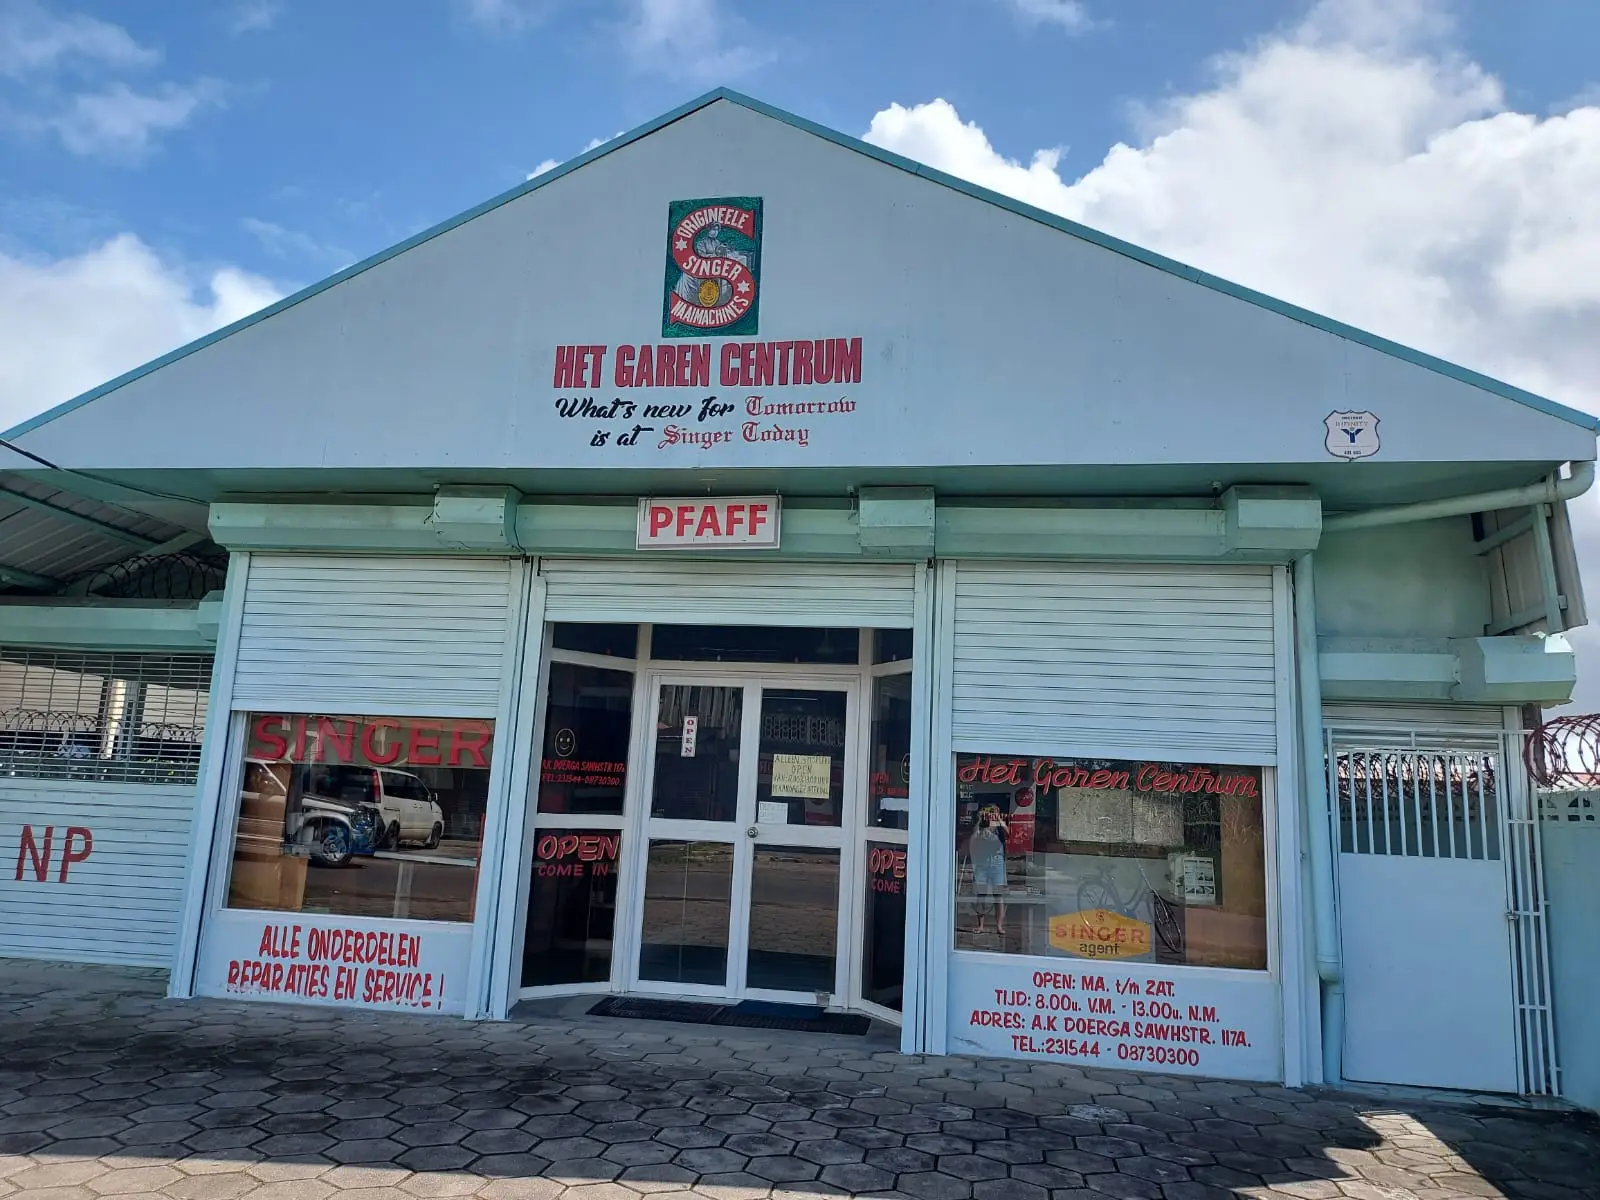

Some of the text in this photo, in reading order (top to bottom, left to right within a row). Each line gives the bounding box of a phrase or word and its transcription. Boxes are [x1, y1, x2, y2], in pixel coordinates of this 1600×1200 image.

[677, 207, 749, 239] ORIGINEELE
[683, 255, 742, 281] SINGER
[671, 295, 749, 326] NAAIMACHINES
[553, 337, 863, 388] HET GAREN CENTRUM
[555, 394, 856, 422] What's new for Tomorrow
[590, 421, 810, 449] is at Singer Today
[649, 504, 768, 537] PFAFF
[252, 715, 494, 767] SINGER
[959, 755, 1260, 798] Het Garen Centrum
[15, 825, 93, 884] NP
[537, 835, 620, 862] OPEN
[869, 848, 907, 878] OPE
[538, 862, 609, 877] COME IN
[871, 879, 900, 893] COME
[258, 925, 421, 968] ALLE ONDERDELEN
[1055, 923, 1146, 944] SINGER
[1079, 942, 1120, 957] agent
[227, 960, 330, 998] REPARATIES
[334, 966, 359, 1000] EN
[362, 967, 432, 1008] SERVICE
[1032, 971, 1076, 990] OPEN:
[1081, 976, 1110, 992] MA.
[1115, 977, 1140, 995] t/m
[995, 989, 1031, 1007] TIJD:
[1035, 993, 1082, 1012] 8.00u.
[1087, 997, 1116, 1014] V.M.
[1132, 1000, 1183, 1020] 13.00u.
[1188, 1005, 1220, 1022] N.M.
[970, 1010, 1252, 1047] ADRES: A.K DOERGA SAWHSTR. 117A.
[1117, 1043, 1200, 1067] 08730300
